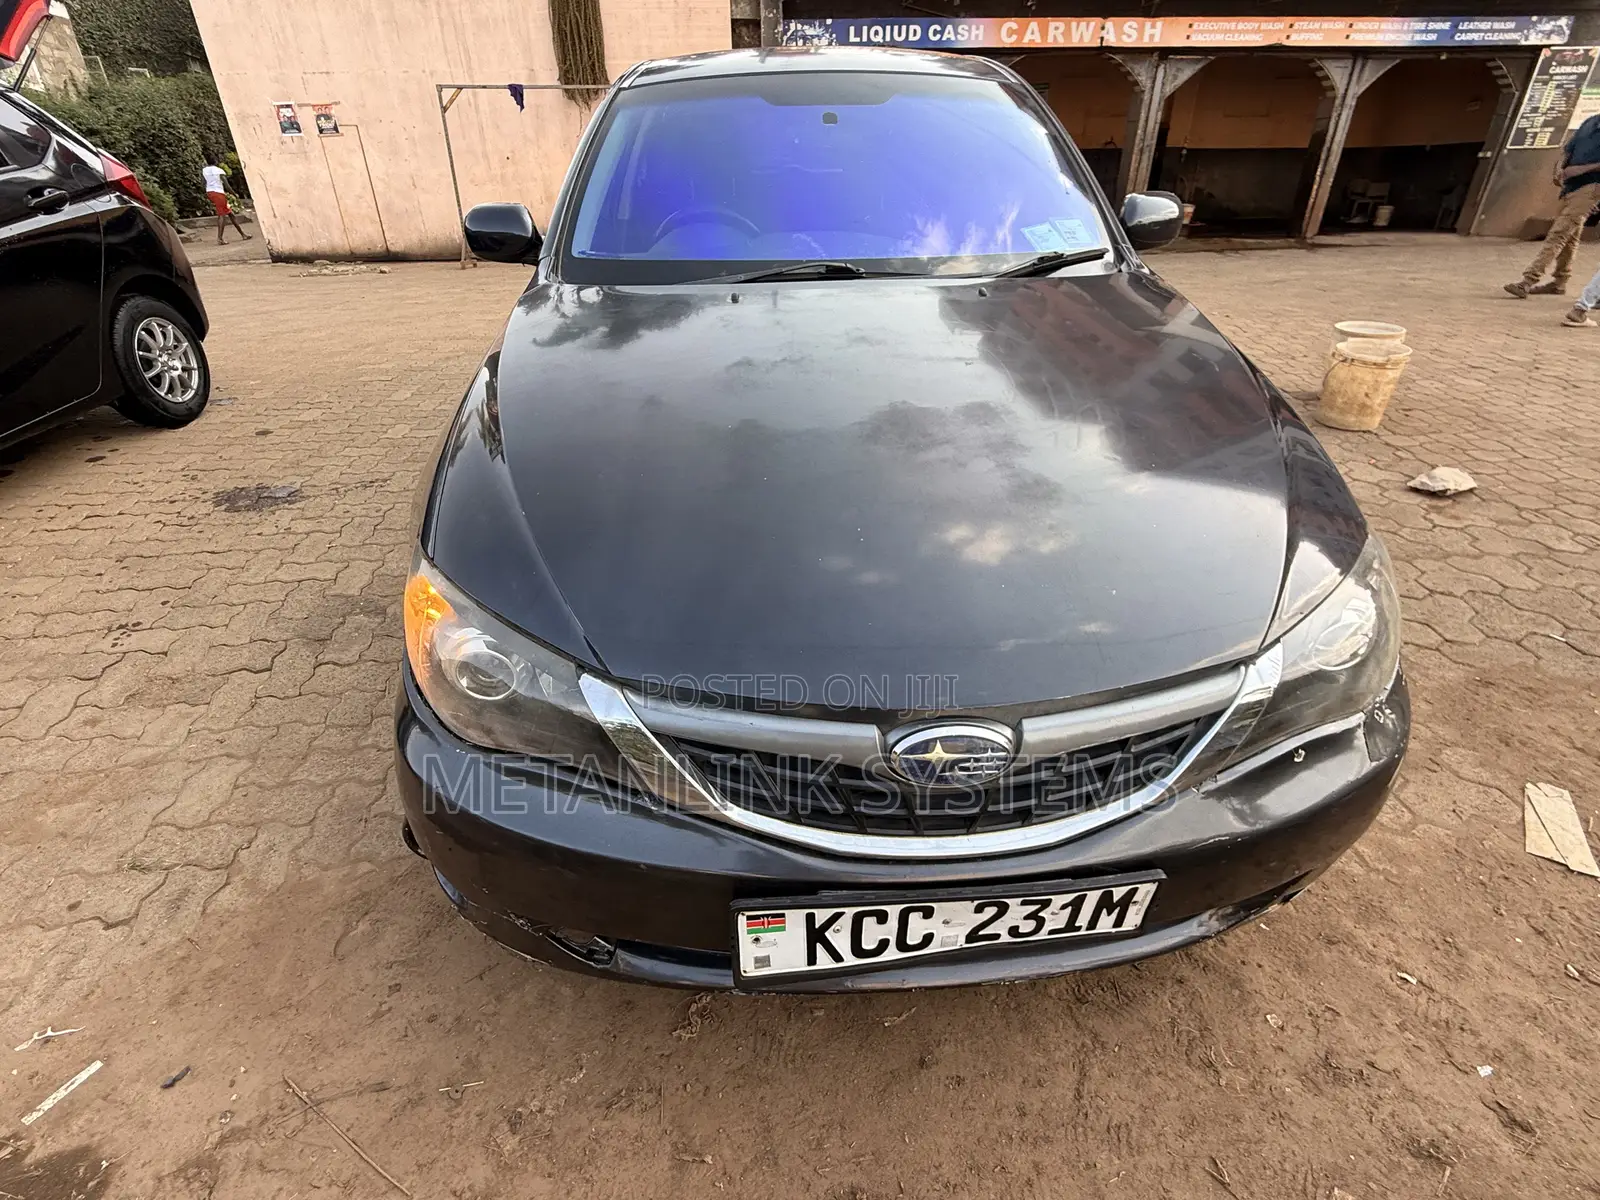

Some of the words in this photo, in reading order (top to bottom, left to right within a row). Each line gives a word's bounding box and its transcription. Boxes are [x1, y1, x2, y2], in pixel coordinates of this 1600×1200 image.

[1193, 22, 1237, 30] EXECUTIVE
[1237, 22, 1260, 30] BODY
[1260, 22, 1285, 30] WASH
[1293, 21, 1321, 30] STEAM
[1321, 21, 1346, 30] WASH
[1427, 22, 1452, 30] SHINE
[1458, 21, 1492, 30] LEATHER
[1492, 21, 1516, 30] WASH
[849, 25, 922, 43] LIQIUD
[928, 24, 984, 41] CASH
[1000, 21, 1164, 43] CARWASH
[1454, 32, 1485, 41] CARPET
[1484, 32, 1522, 41] CLEANING
[1191, 33, 1225, 41] VACUUM
[1225, 33, 1264, 41] CLEANING
[1413, 33, 1438, 41] WASH
[1549, 65, 1589, 74] CARWASH
[805, 905, 935, 966] KCC
[965, 887, 1140, 945] 231M
